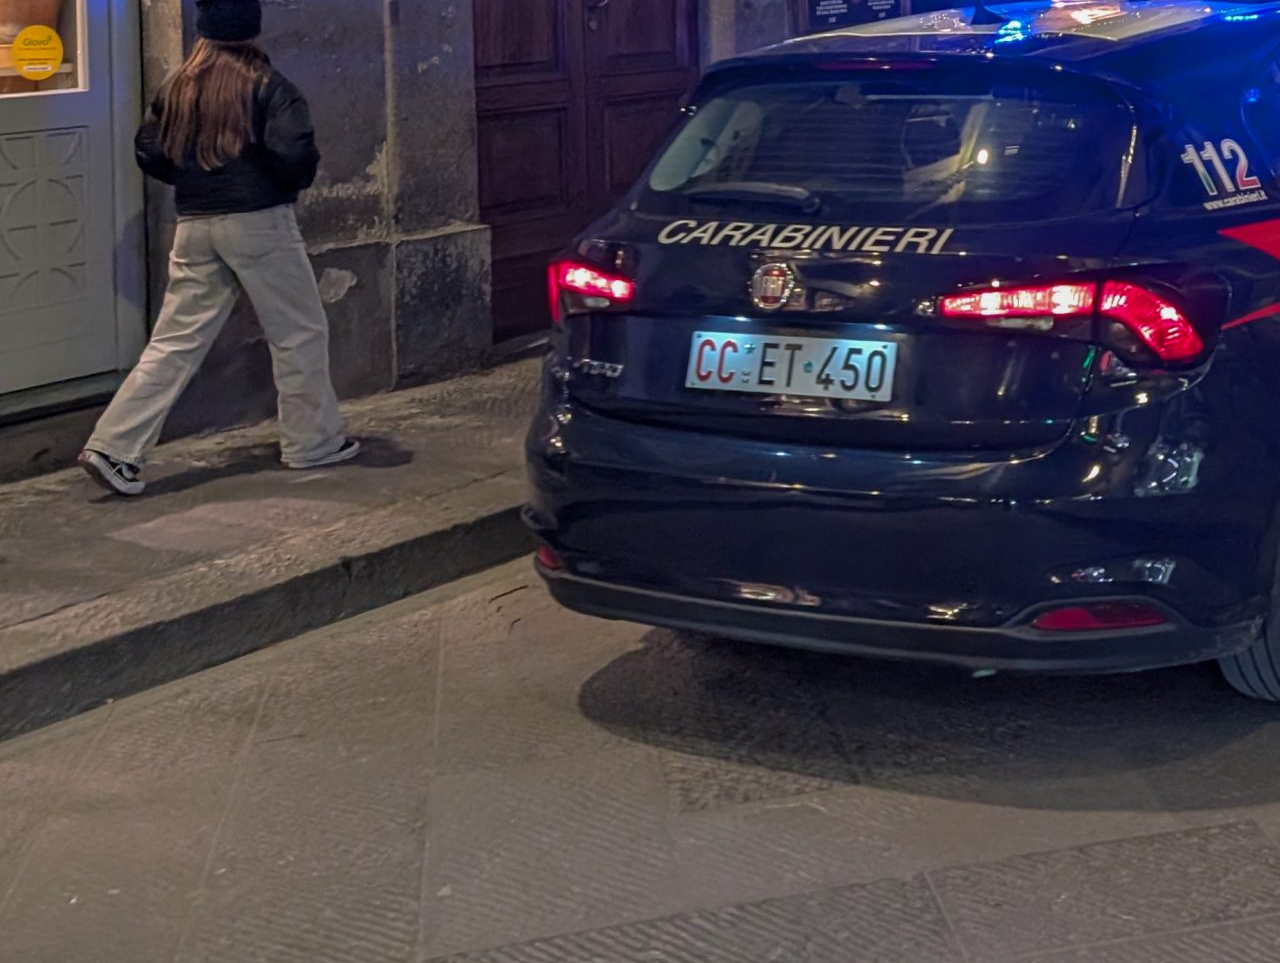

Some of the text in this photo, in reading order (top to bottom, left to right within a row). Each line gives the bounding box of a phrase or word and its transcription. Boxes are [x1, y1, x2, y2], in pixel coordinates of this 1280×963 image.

[1180, 138, 1261, 195] 112
[657, 220, 954, 254] CARABINIERI
[695, 339, 887, 393] CC ET 450
